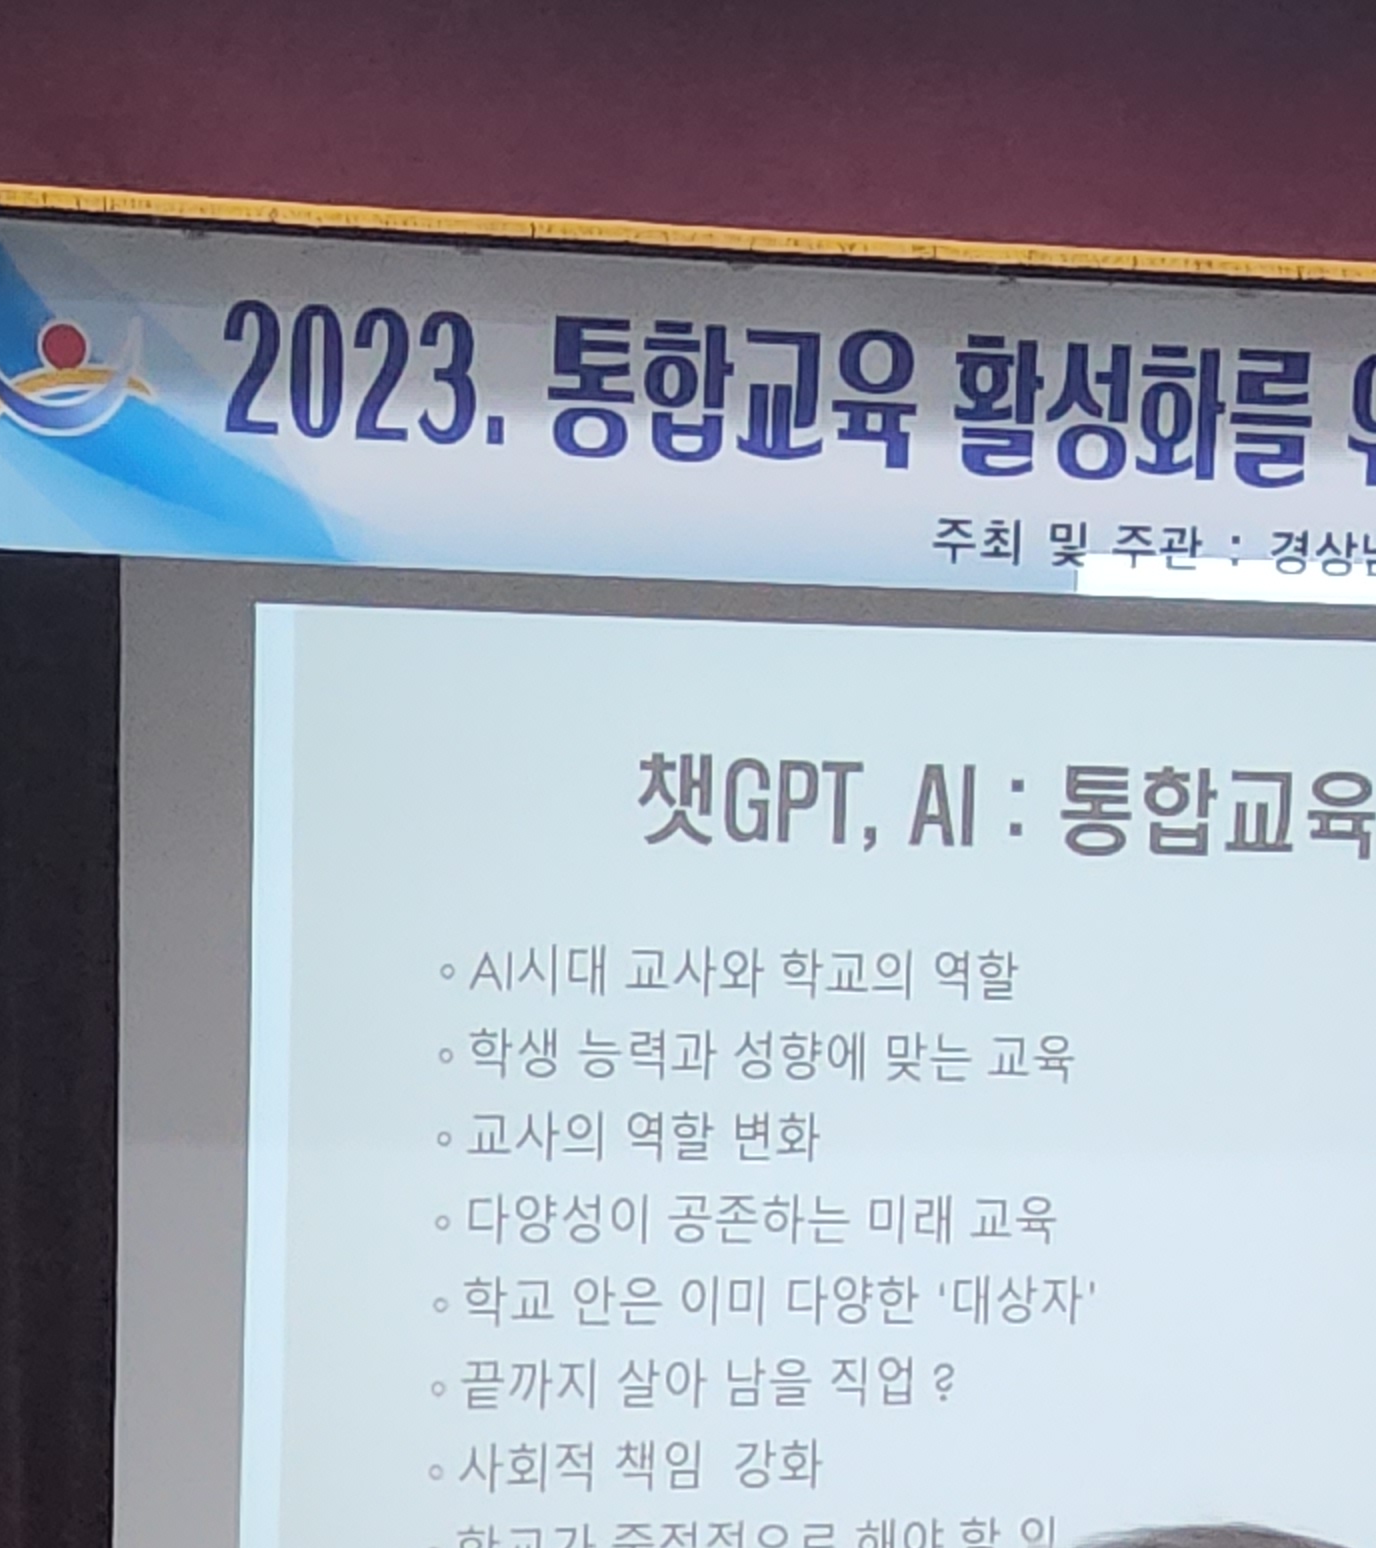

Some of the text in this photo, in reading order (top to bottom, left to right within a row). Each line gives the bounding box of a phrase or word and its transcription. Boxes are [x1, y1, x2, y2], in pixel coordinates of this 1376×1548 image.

[222, 299, 505, 445] 2023.
[546, 315, 918, 469] 통합교육
[953, 334, 1314, 489] 활성화를
[932, 517, 1023, 567] 주최
[1049, 521, 1088, 568] 및
[1111, 524, 1204, 571] 주관
[637, 751, 880, 853] 챗GPT,
[908, 763, 979, 849] AI
[468, 943, 1022, 1003] AI시대 교사와 학교의 역할
[468, 1027, 1078, 1086] 학생 능력과 성향에 맞는 교육
[466, 1110, 823, 1165] 교사의 역할 변화
[467, 1193, 1060, 1248] 다양성이 공존하는 미래 교육
[463, 1275, 557, 1330] 학교
[573, 1275, 665, 1329] 안은
[681, 1275, 767, 1329] 이미
[787, 1274, 922, 1328] 다양한
[460, 1357, 598, 1413] 끝까지
[617, 1357, 710, 1411] 살아
[727, 1356, 814, 1410] 남을
[831, 1355, 915, 1409] 직업
[458, 1437, 825, 1496] 사회적 책임 강화
